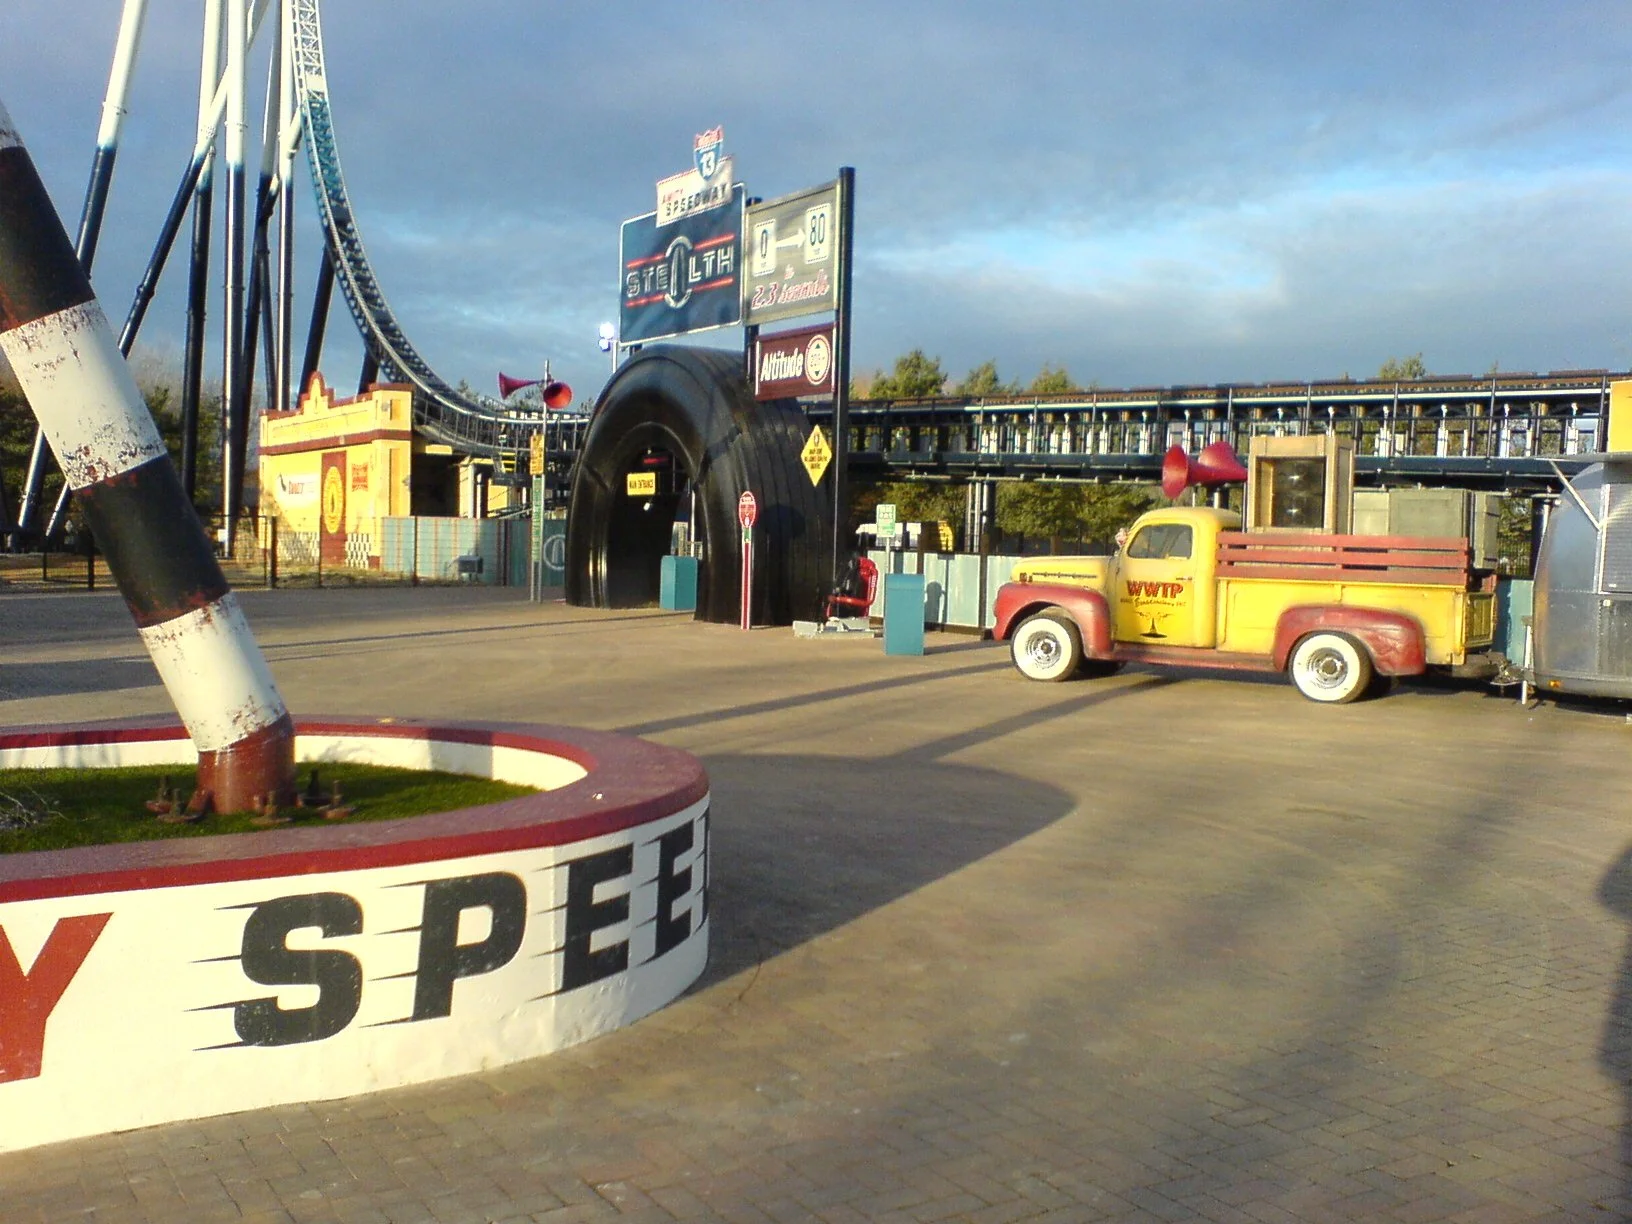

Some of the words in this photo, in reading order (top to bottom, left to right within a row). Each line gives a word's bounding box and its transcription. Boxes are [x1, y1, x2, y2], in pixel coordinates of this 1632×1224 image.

[666, 182, 727, 217] SPEEDWAY
[809, 213, 826, 246] 80
[626, 242, 735, 301] STEALTH
[751, 281, 778, 310] 2.3
[760, 347, 804, 382] Altitude
[1127, 580, 1183, 598] WWTP
[184, 806, 709, 1052] SPEE
